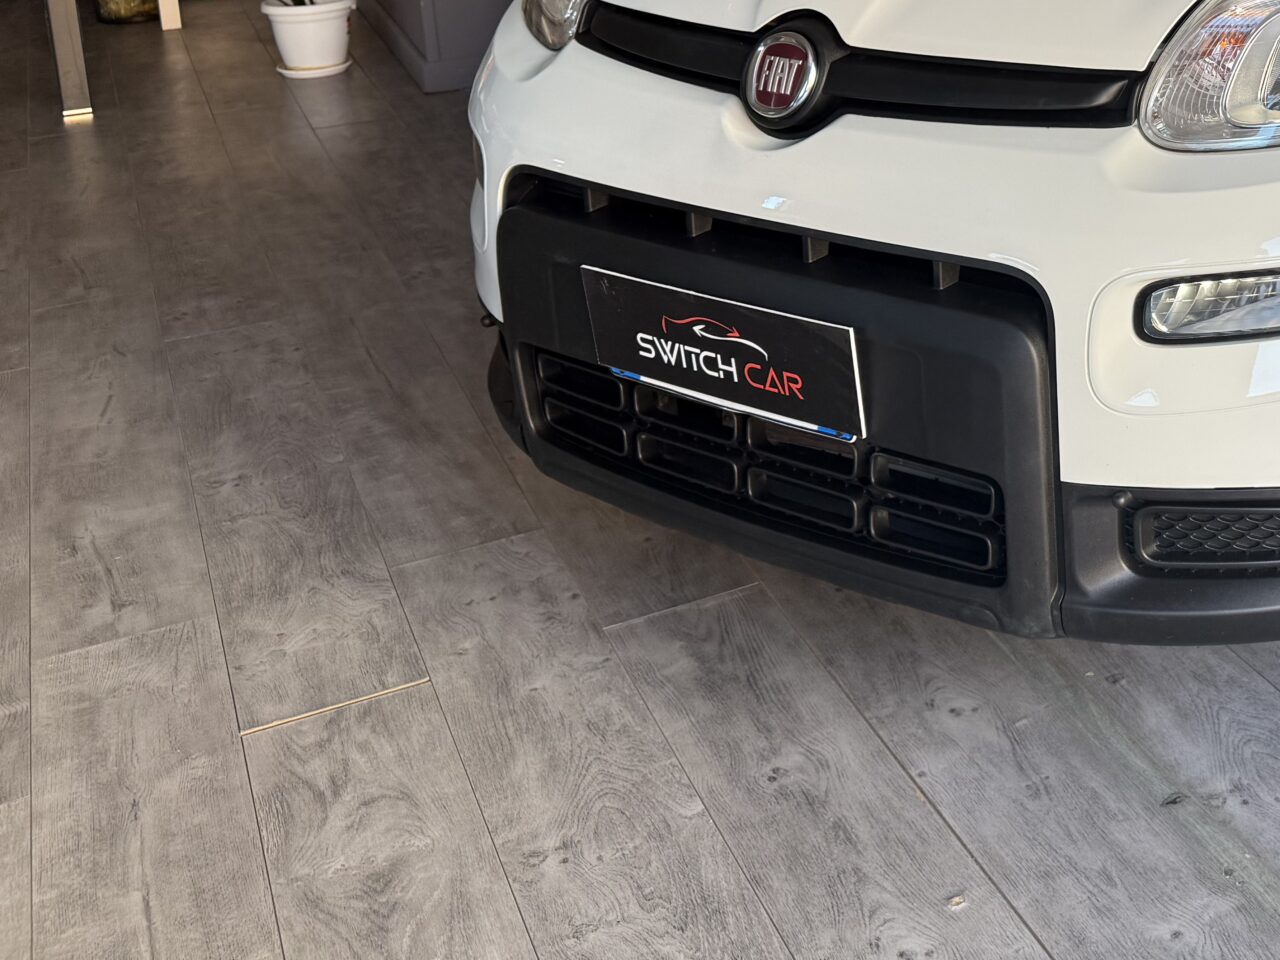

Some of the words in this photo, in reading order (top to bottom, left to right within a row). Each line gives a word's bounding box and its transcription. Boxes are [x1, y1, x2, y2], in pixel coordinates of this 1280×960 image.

[759, 55, 802, 95] FIAT
[636, 332, 738, 383] SWITCH
[744, 362, 804, 400] CAR
